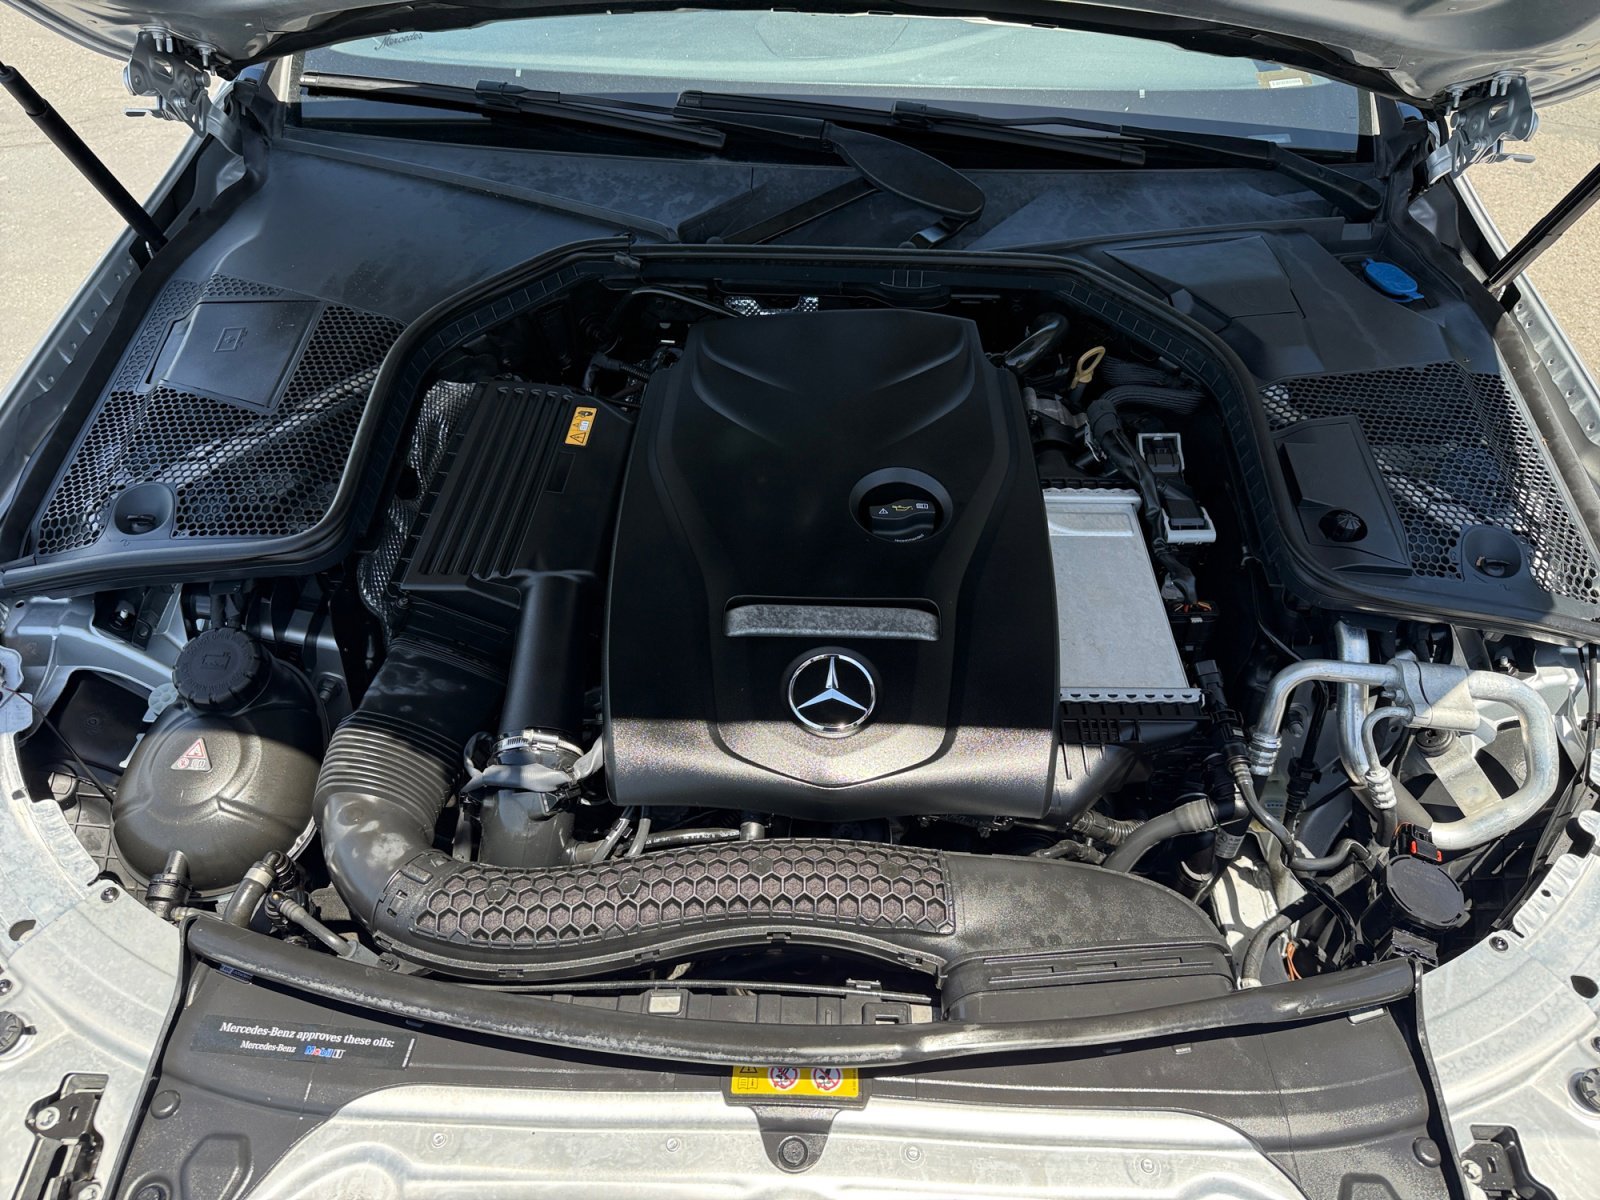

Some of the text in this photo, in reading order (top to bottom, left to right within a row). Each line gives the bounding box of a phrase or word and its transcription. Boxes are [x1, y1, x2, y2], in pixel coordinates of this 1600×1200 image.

[374, 31, 423, 51] Mercedes
[219, 1022, 395, 1048] Mercedes-Benz approves these oils:
[240, 1040, 297, 1053] Mercedes-Benz
